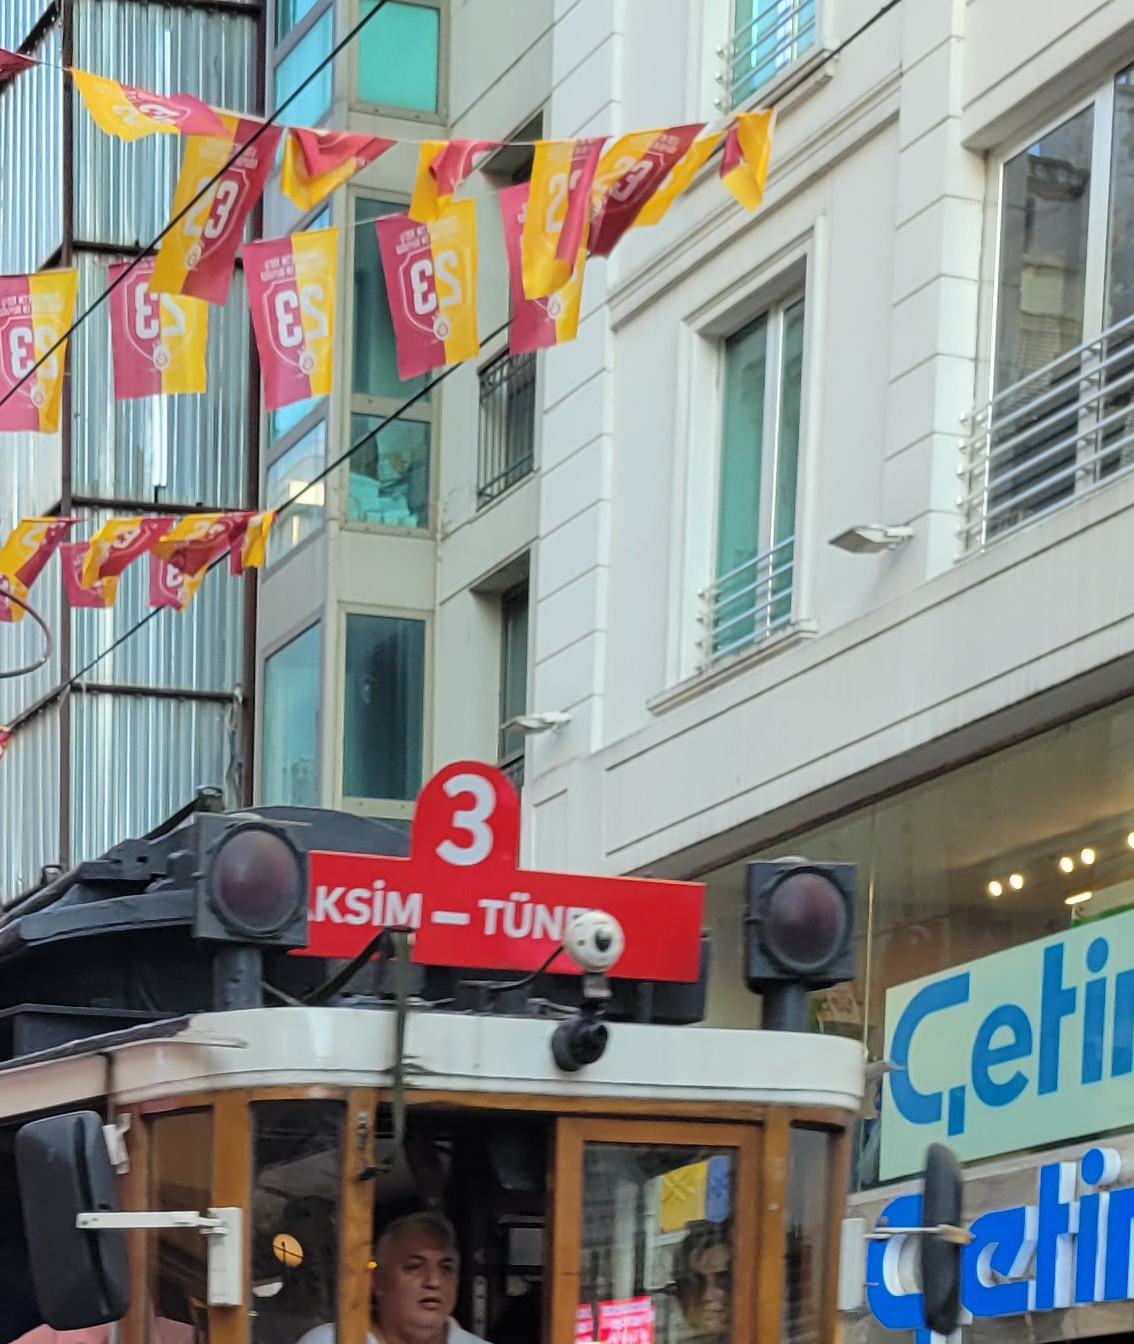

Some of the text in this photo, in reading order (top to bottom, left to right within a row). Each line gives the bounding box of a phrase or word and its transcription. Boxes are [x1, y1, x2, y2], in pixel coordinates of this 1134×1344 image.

[184, 176, 239, 239] 23
[435, 773, 497, 866] 3
[307, 879, 423, 928] KSİM
